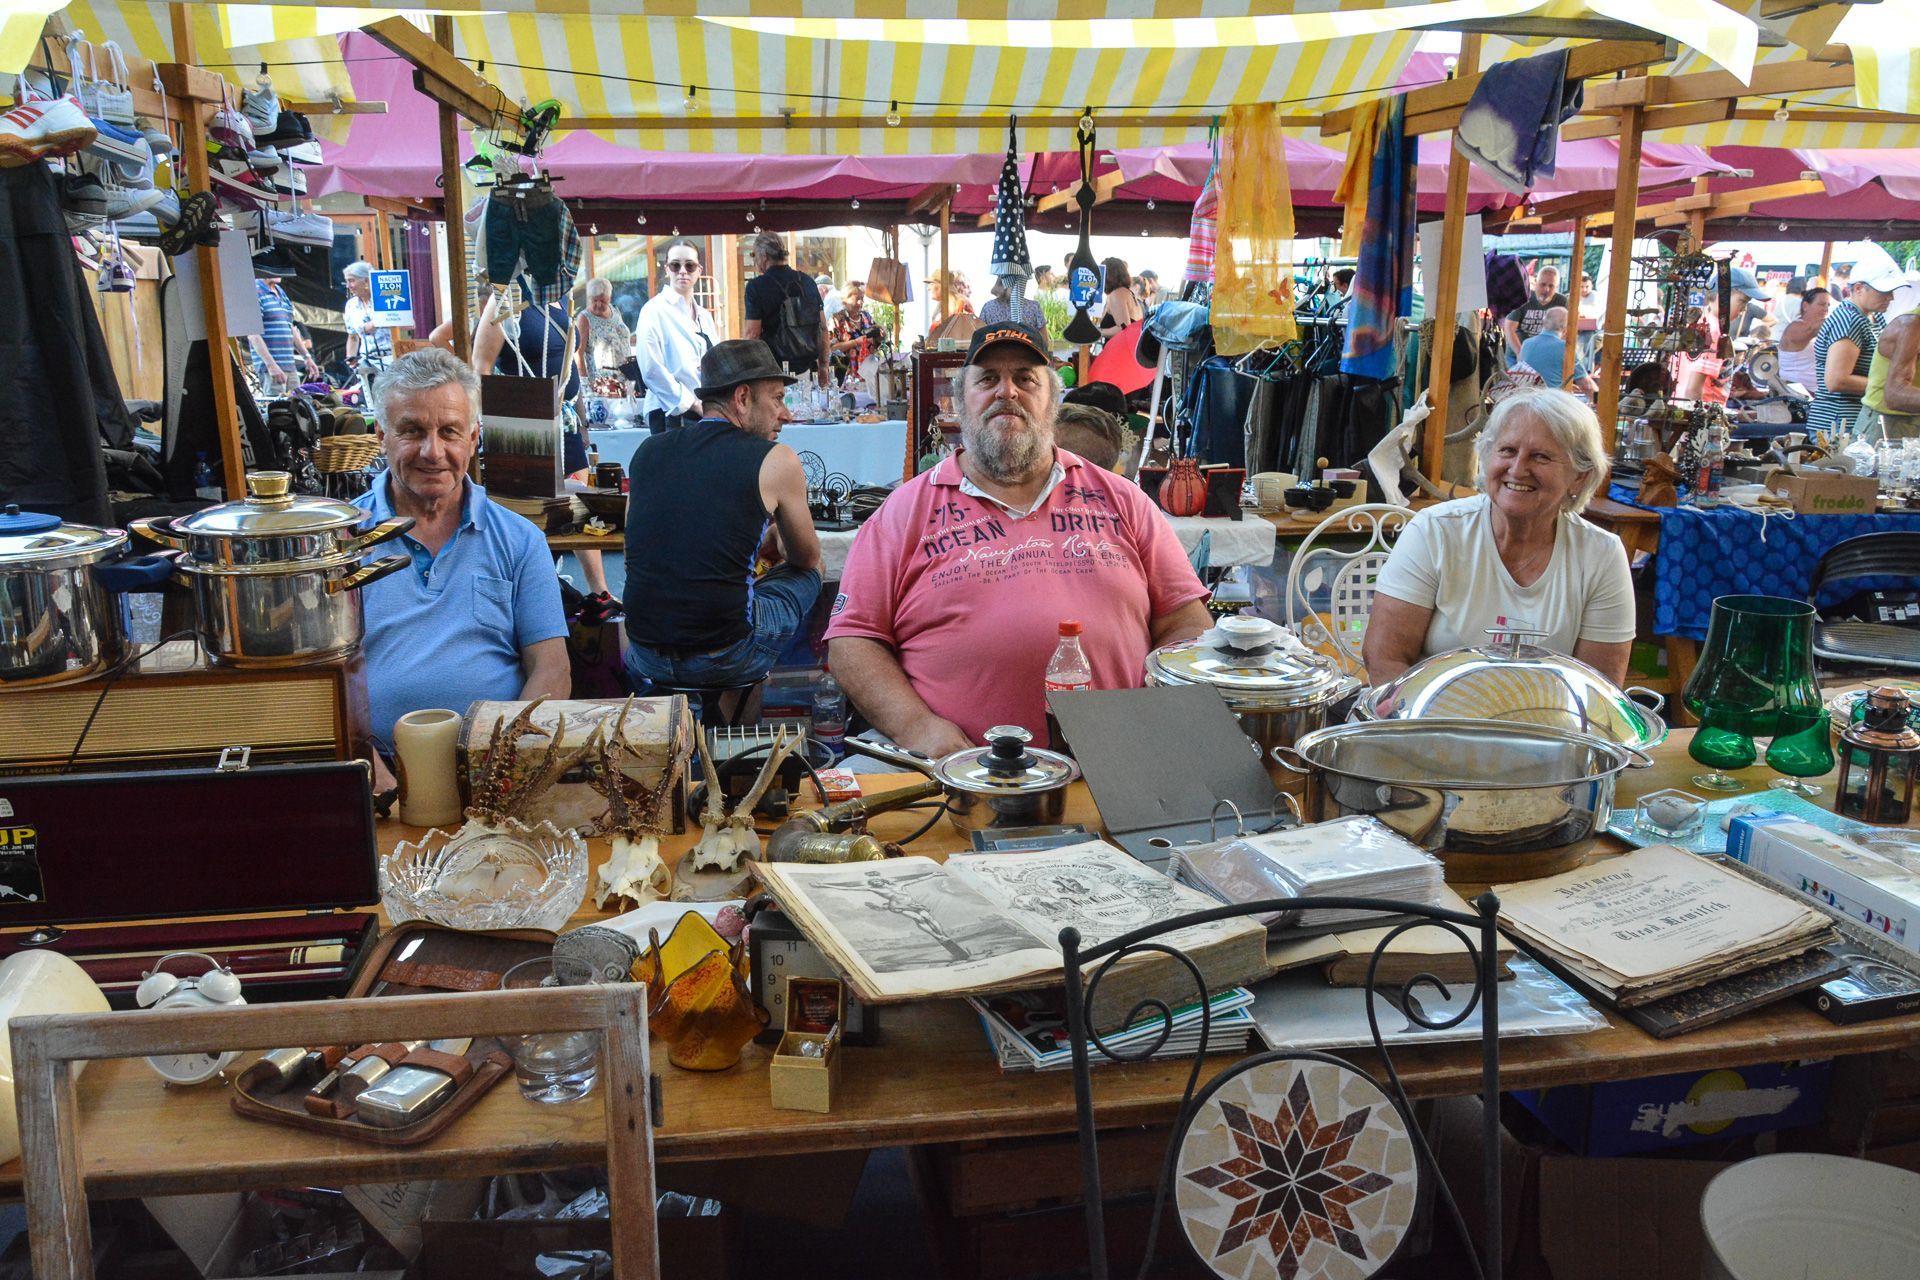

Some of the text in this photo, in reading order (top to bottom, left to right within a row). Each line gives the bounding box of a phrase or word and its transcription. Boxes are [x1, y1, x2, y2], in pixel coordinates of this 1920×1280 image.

[384, 298, 398, 310] 17
[1689, 294, 1700, 304] 15
[985, 329, 1033, 344] STIHL
[1813, 494, 1866, 509] froddo
[1051, 512, 1121, 537] DRIFT
[924, 519, 1007, 559] OCEAN
[931, 564, 970, 583] ENJOY
[980, 558, 1003, 569] THE
[1010, 549, 1054, 564] ANNUAL
[786, 941, 798, 953] 11
[770, 954, 784, 966] 10
[767, 973, 776, 985] 9
[774, 993, 782, 1005] 8
